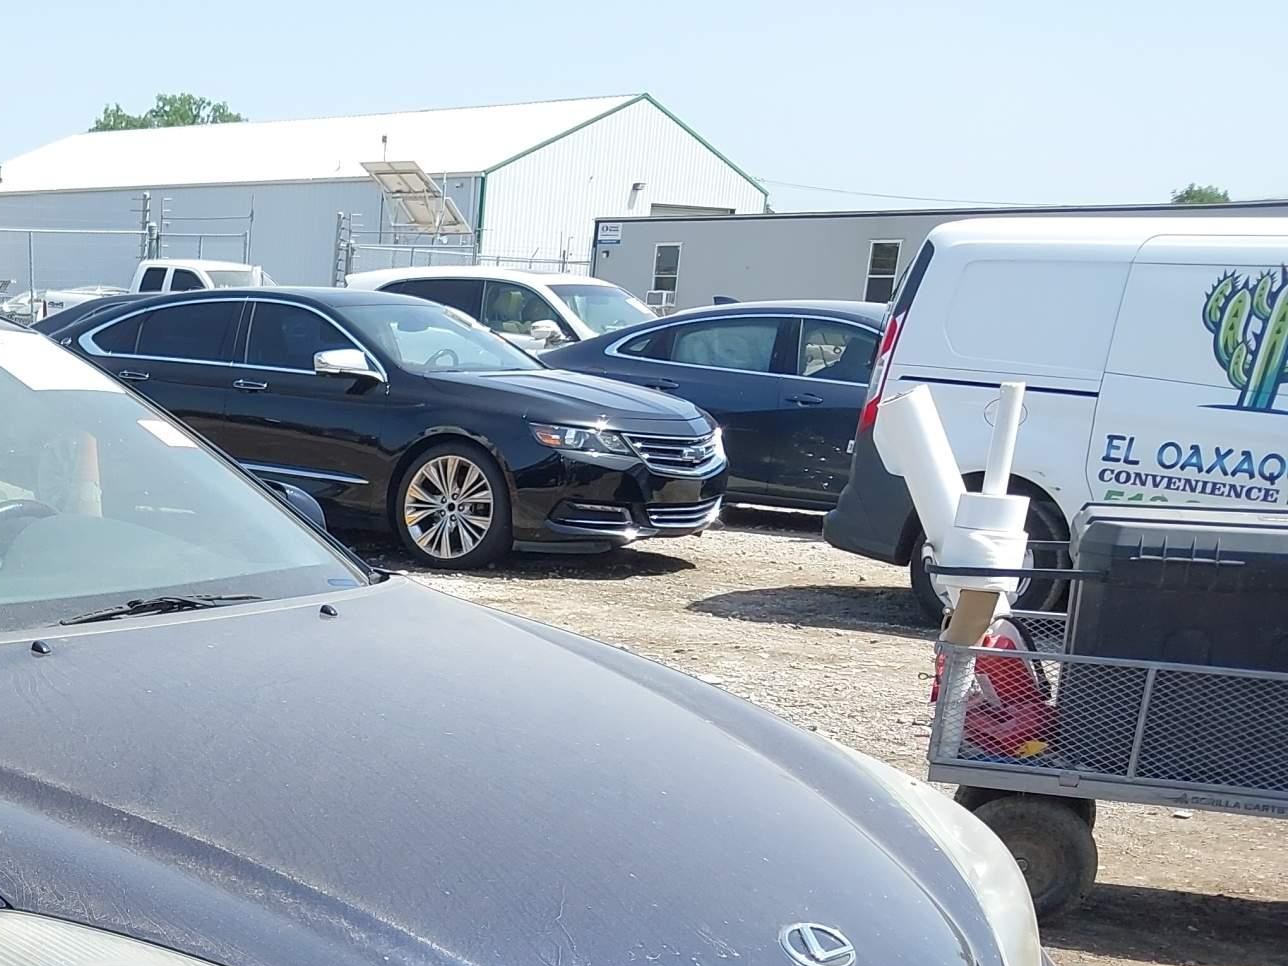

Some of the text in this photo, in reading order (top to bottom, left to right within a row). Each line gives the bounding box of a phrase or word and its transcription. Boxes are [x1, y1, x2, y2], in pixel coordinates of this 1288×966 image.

[1101, 433, 1288, 486] EL OAXAQ
[1098, 467, 1281, 503] CONVENIENCE
